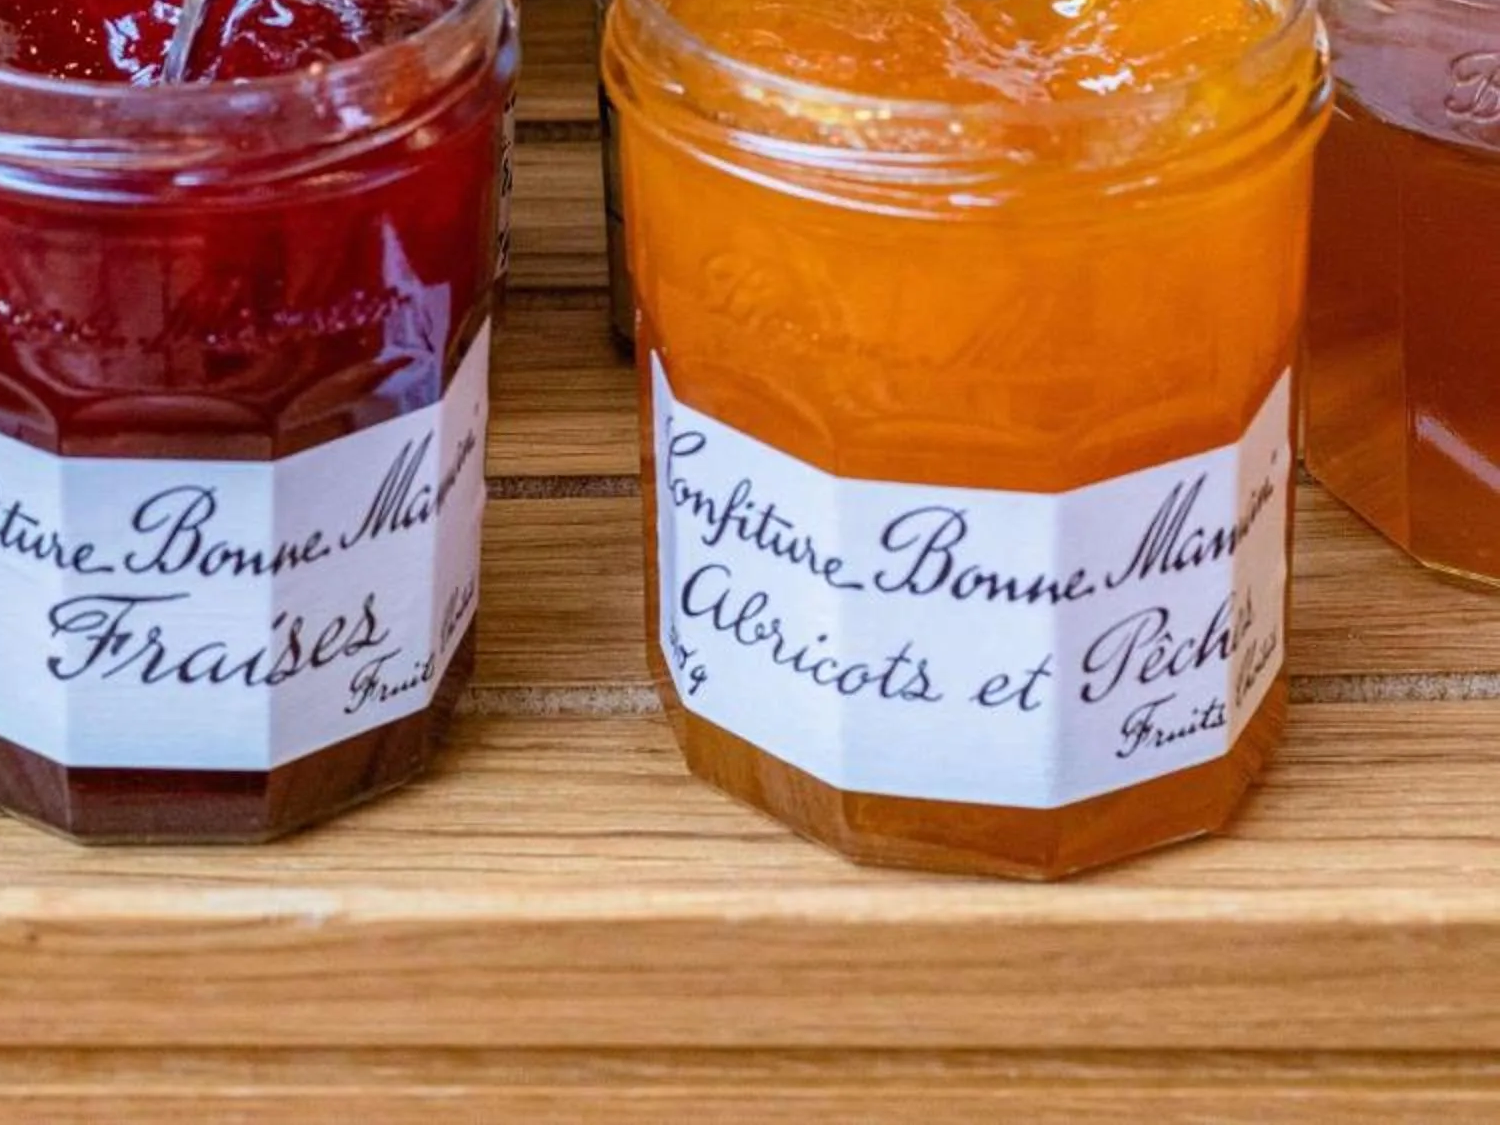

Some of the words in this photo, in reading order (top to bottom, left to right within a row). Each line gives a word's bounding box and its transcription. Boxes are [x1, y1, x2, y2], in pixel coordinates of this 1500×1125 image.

[122, 485, 332, 576] Bonne
[874, 505, 1097, 605] Bonne
[47, 591, 390, 686] Fraises
[681, 563, 943, 703] Abricots
[970, 649, 1058, 712] et
